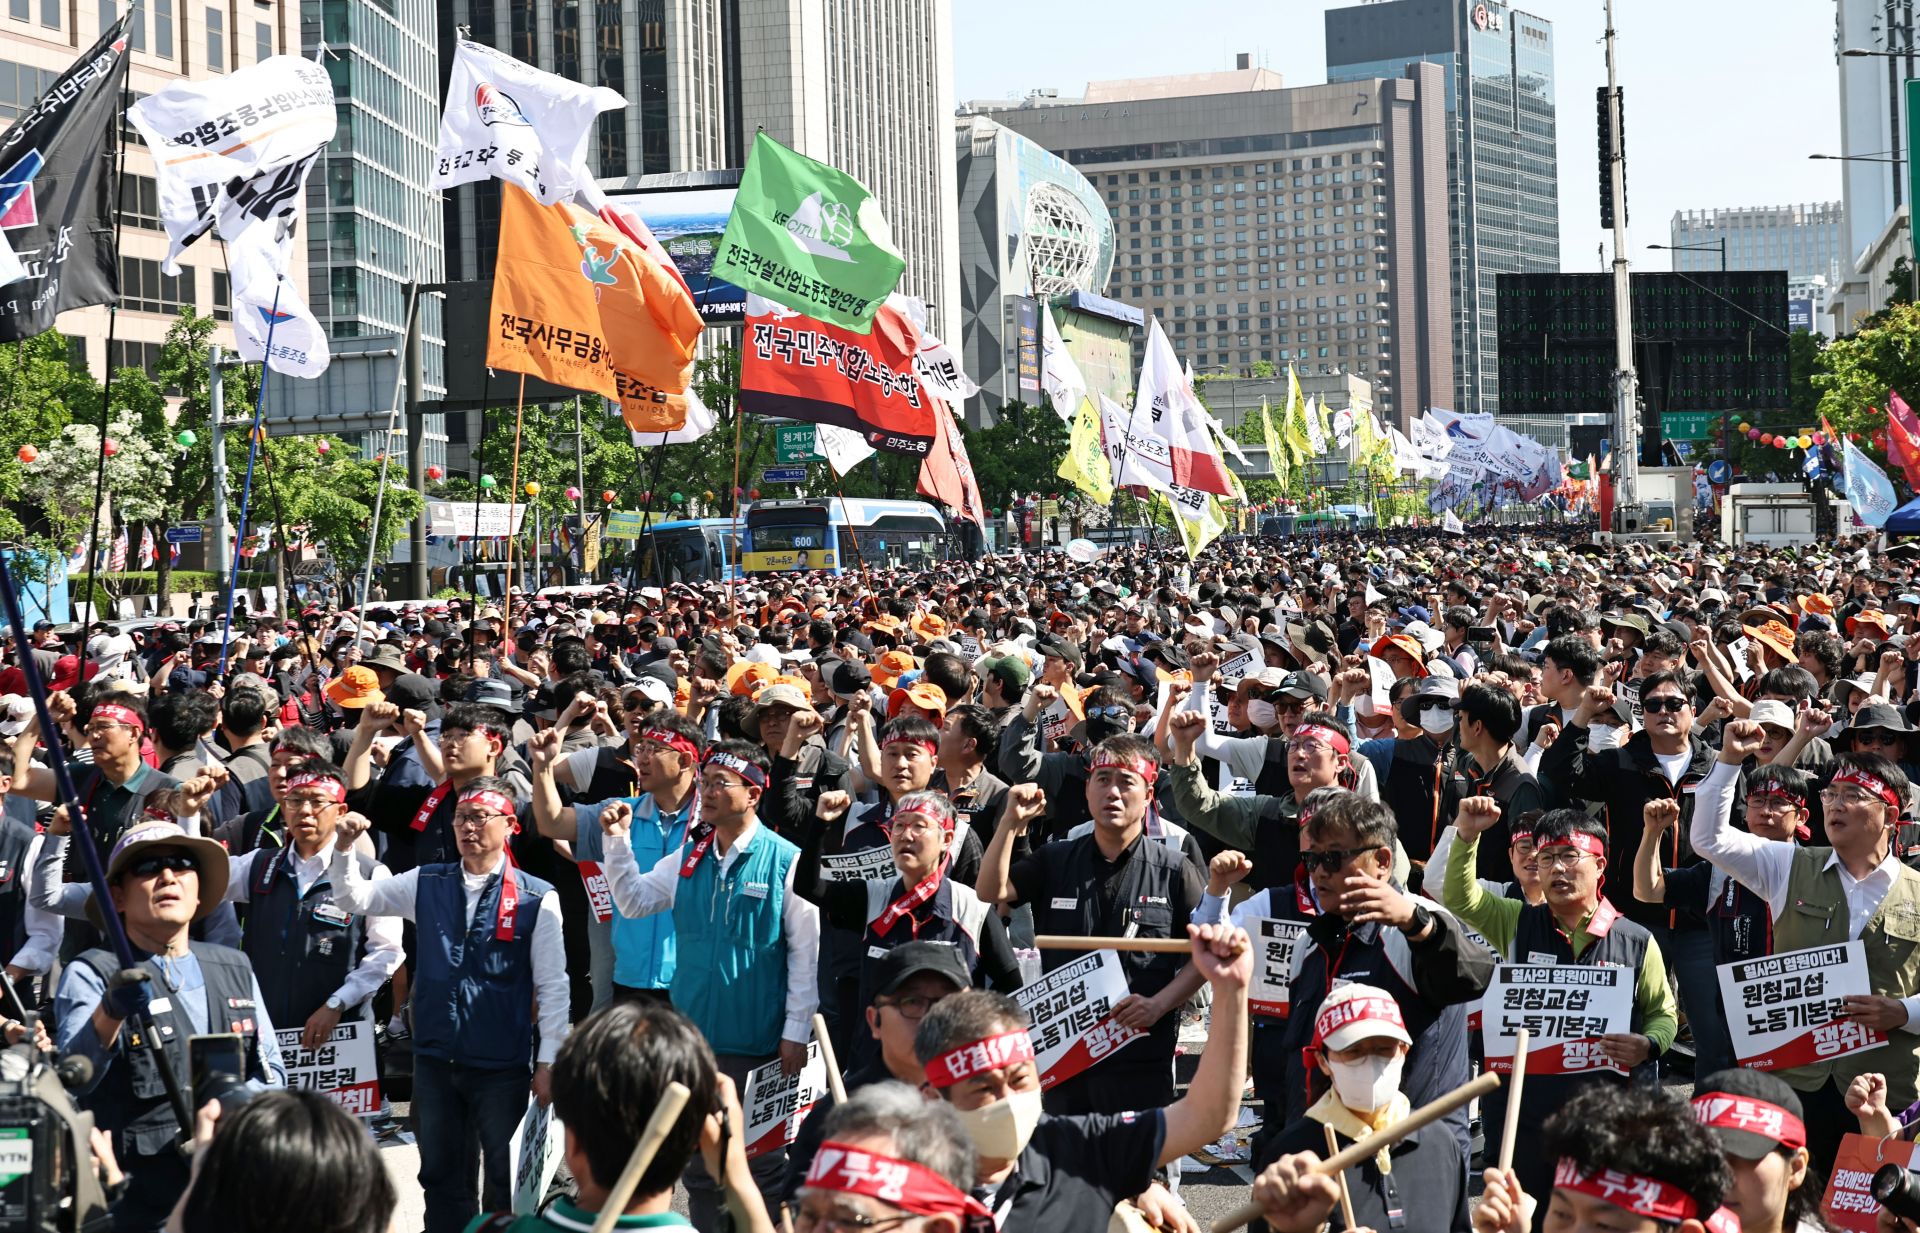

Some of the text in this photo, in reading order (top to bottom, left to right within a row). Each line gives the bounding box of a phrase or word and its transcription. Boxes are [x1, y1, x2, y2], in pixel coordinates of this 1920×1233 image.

[1041, 107, 1130, 123] PLAZA
[669, 240, 712, 256] 놀라운
[710, 303, 741, 314] 기념식에
[886, 437, 928, 453] 민주노총
[794, 536, 812, 547] 600
[1857, 769, 1886, 794] 투쟁
[1511, 968, 1612, 986] 열사의 염원이다!
[1743, 949, 1843, 980] 열사의 염원이다!
[1016, 956, 1098, 1002] 열사의 염원이다!
[1318, 1005, 1345, 1038] 단결
[1500, 1014, 1609, 1039] 노동기본권
[1747, 997, 1849, 1037] 노동기본권
[1812, 1021, 1877, 1057] 쟁취!
[946, 1045, 993, 1080] 단결
[1753, 1059, 1774, 1069] 민주노총
[748, 1086, 813, 1129] 노동기본권
[1731, 1100, 1784, 1138] 투쟁
[838, 1151, 911, 1201] 투쟁
[1597, 1168, 1663, 1213] 투쟁
[1830, 1190, 1877, 1215] 민주주의
